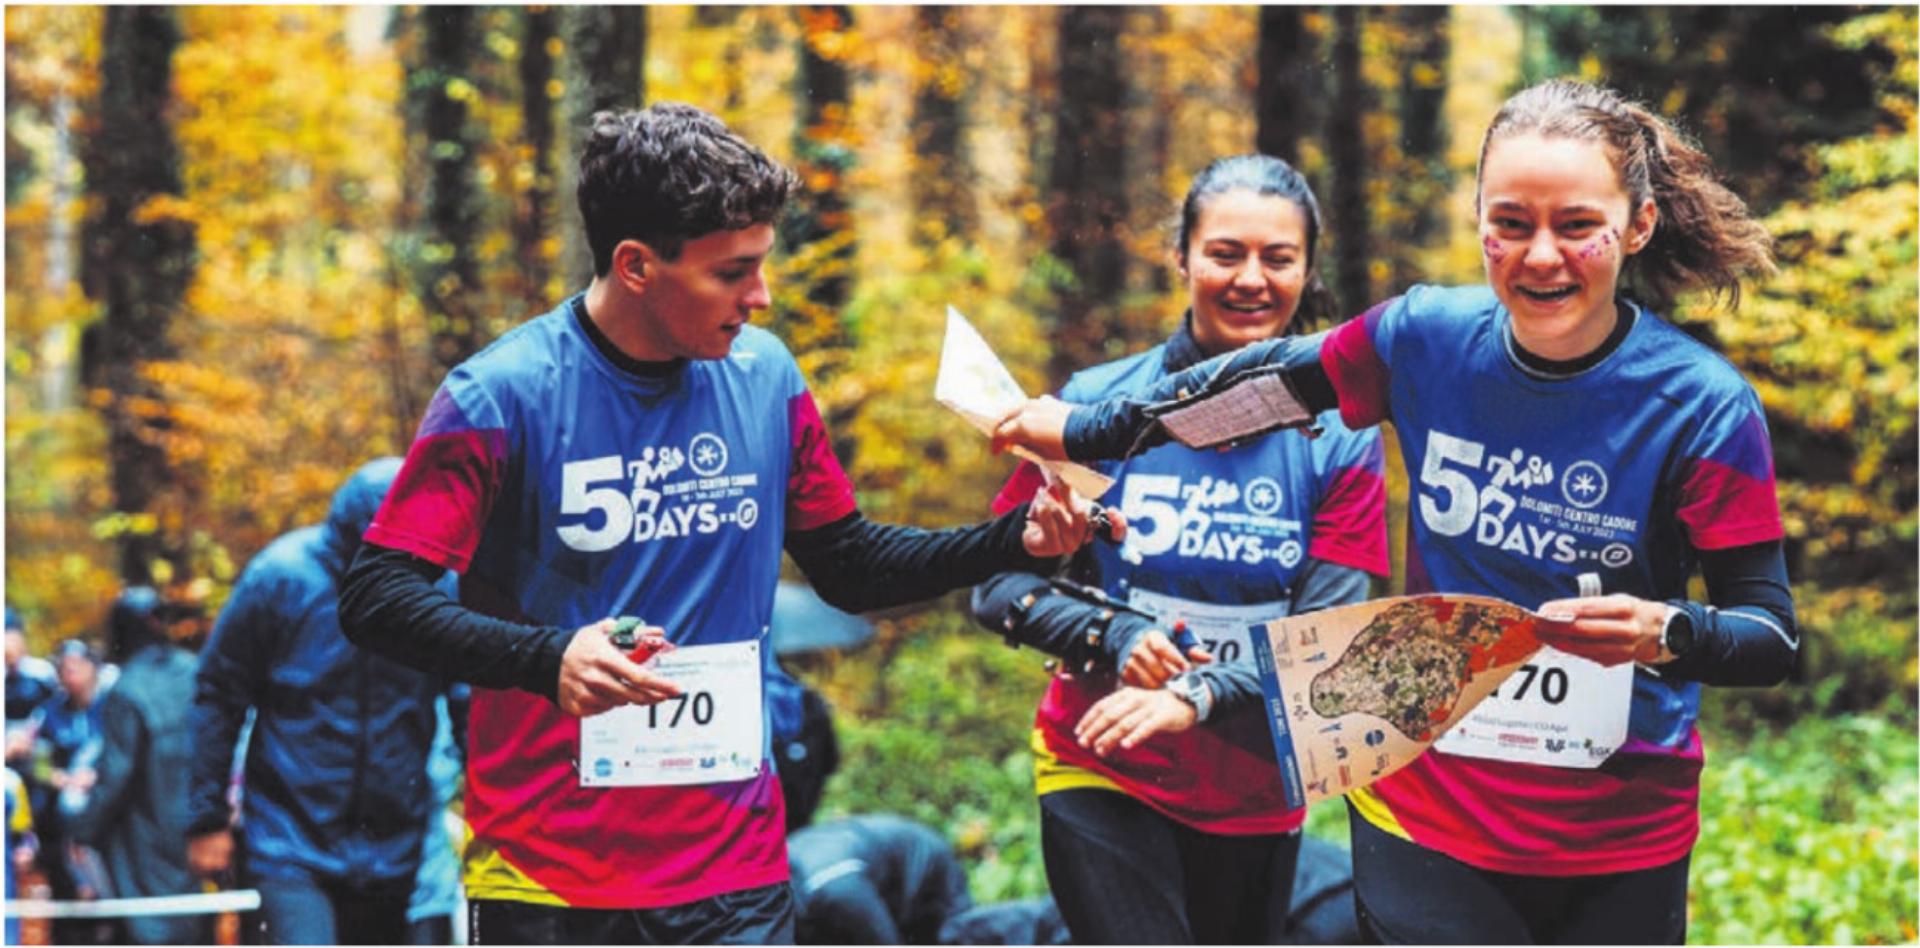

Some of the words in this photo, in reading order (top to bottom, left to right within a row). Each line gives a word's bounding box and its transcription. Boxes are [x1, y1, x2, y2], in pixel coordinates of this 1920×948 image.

[556, 455, 634, 552] 5
[634, 502, 719, 543] DAYS
[1121, 473, 1181, 555] 5
[1179, 529, 1264, 564] DAYS
[1418, 429, 1485, 537] 5
[1476, 512, 1578, 563] DAYS
[1489, 664, 1569, 705] 70
